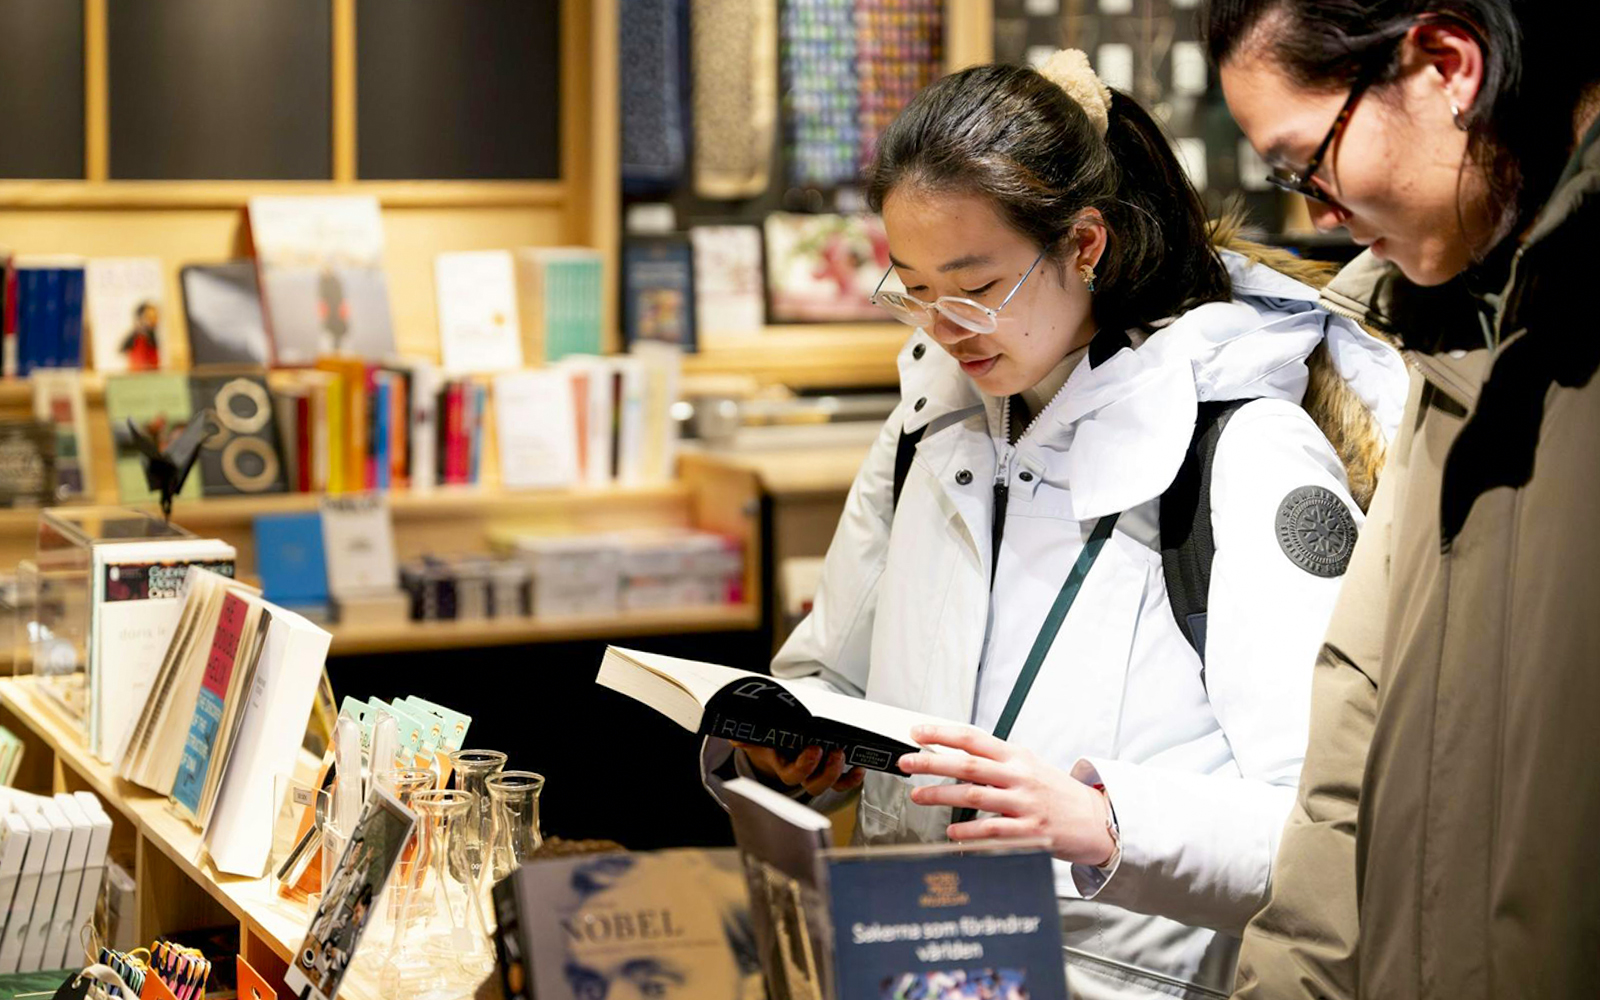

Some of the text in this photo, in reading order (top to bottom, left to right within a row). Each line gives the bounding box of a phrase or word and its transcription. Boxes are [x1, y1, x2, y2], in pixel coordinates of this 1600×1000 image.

[560, 908, 686, 945] NOBEL
[852, 913, 1041, 944] Sakerna som förändrar
[915, 939, 984, 962] världen
